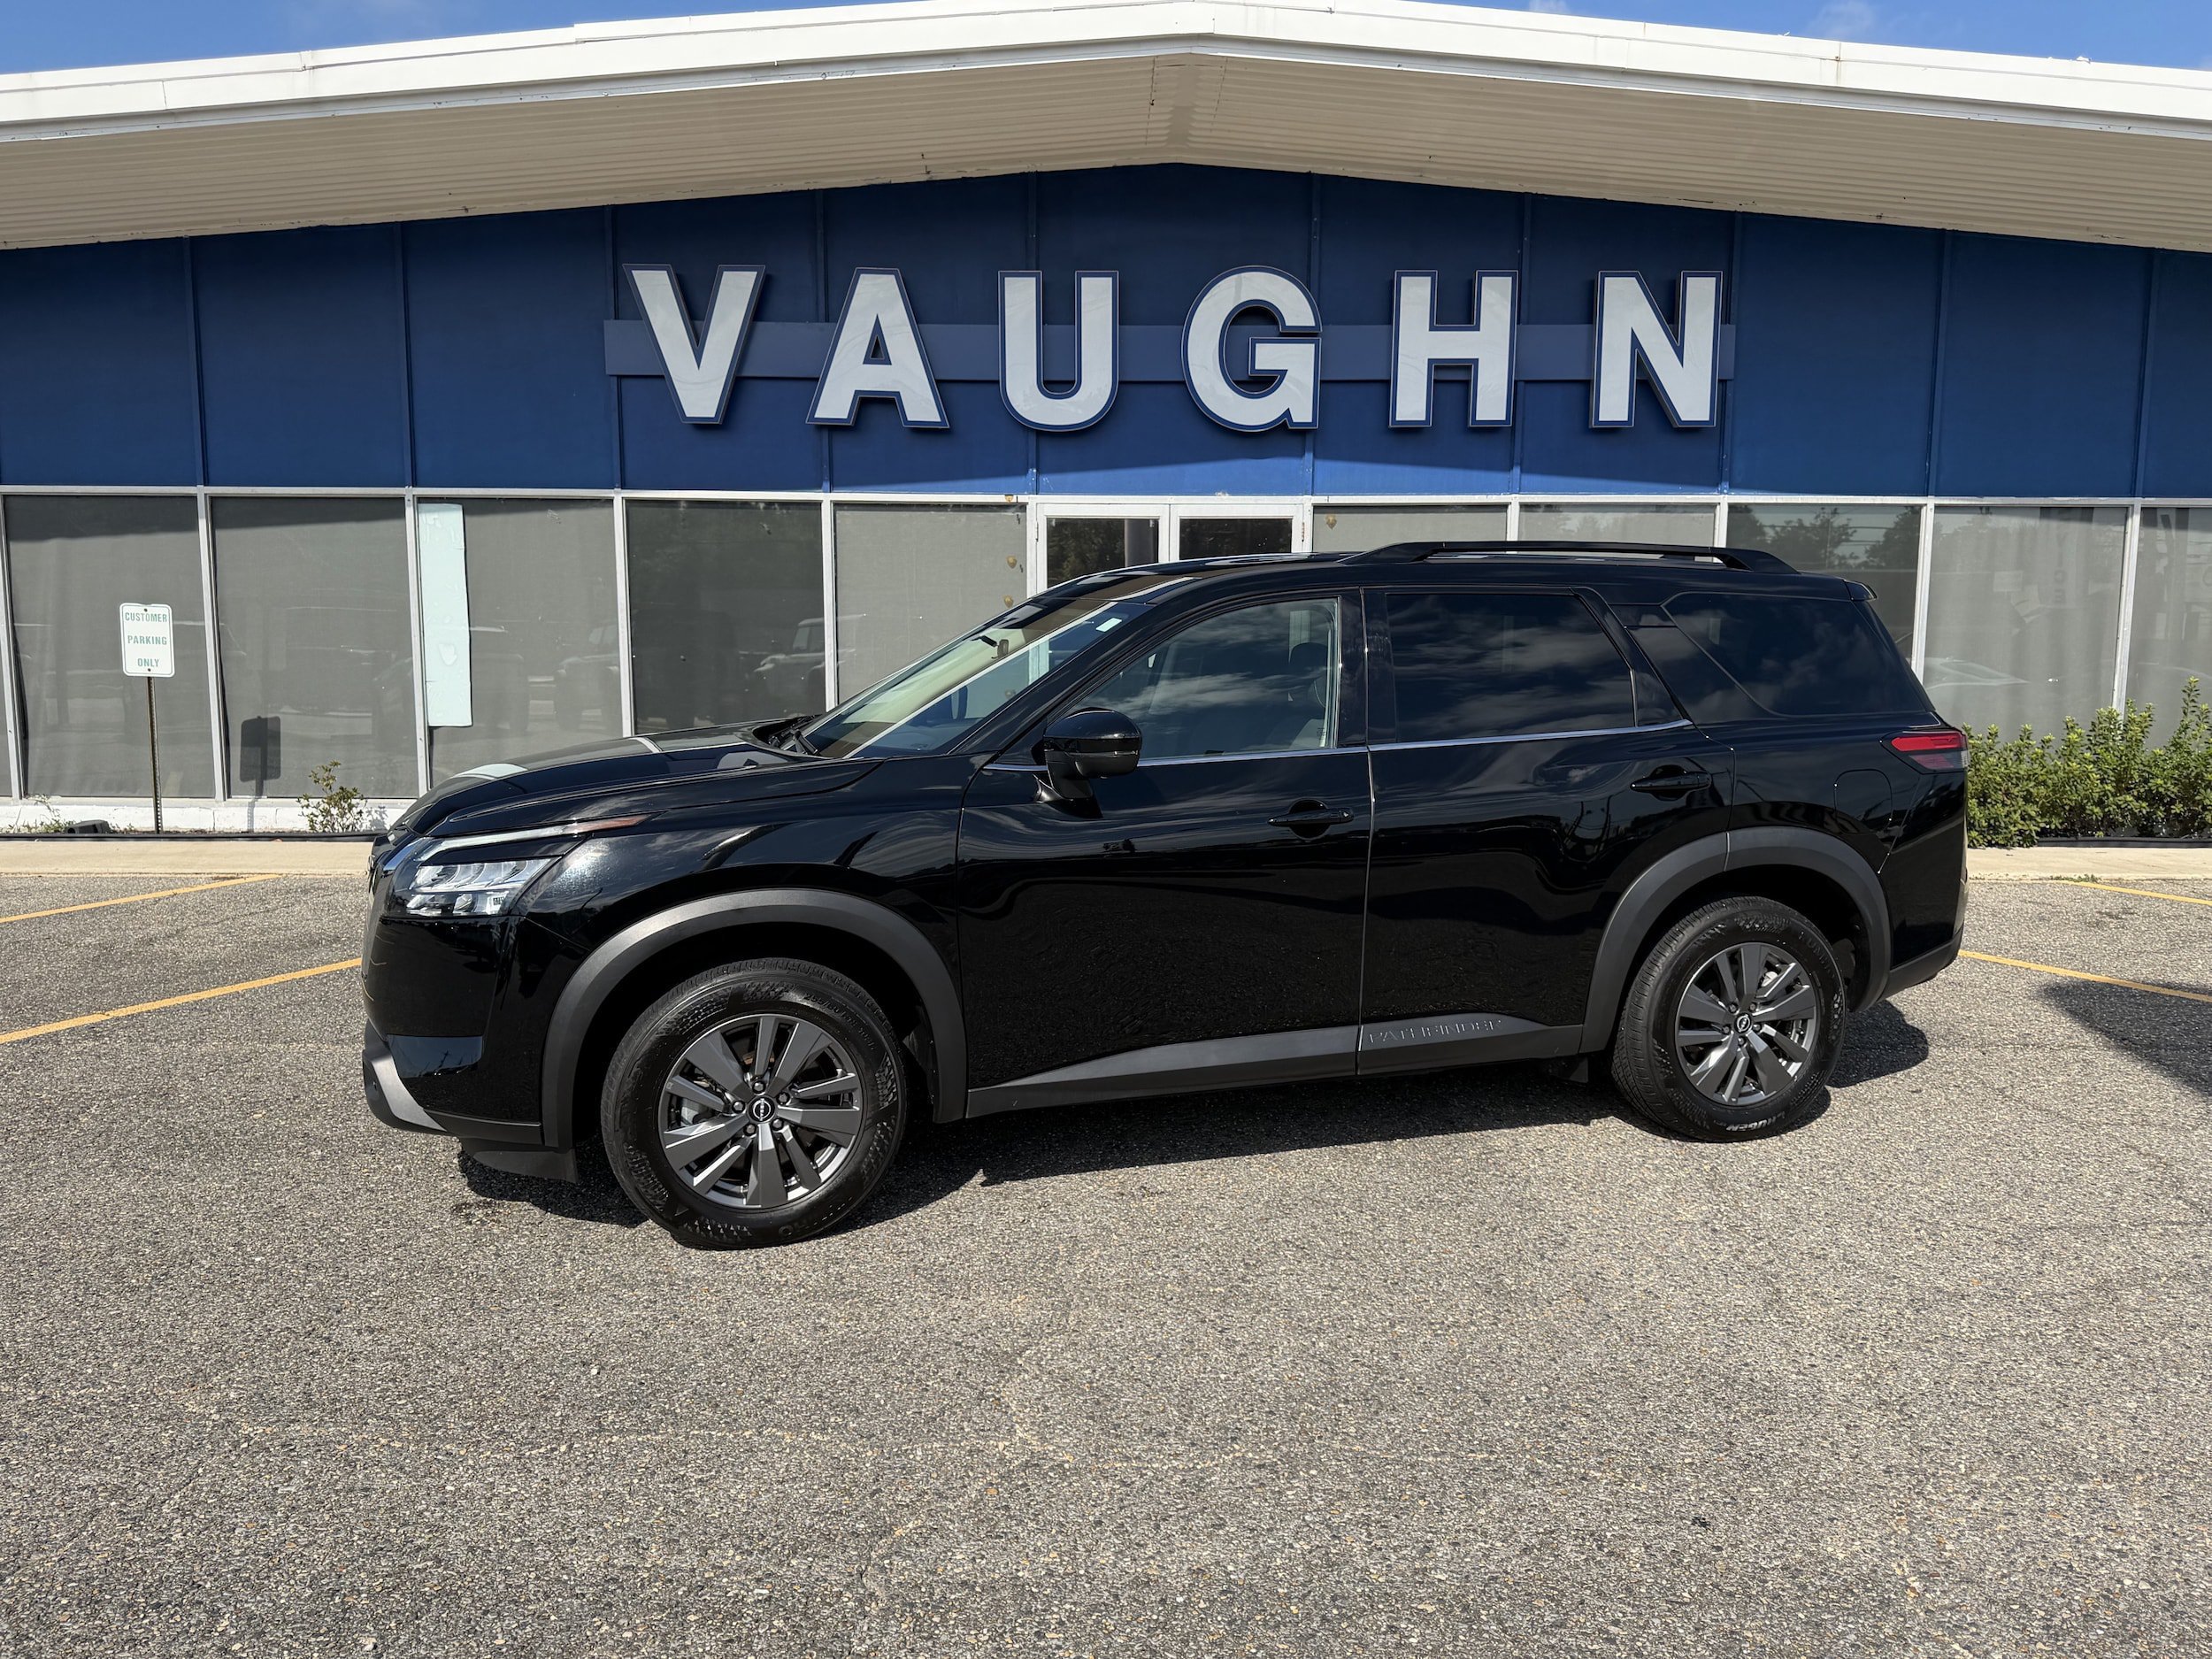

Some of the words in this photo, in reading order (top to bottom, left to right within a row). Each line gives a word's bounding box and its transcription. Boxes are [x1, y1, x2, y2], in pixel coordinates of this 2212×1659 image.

[622, 265, 1724, 433] VAUGHN
[125, 612, 167, 623] CUSTOMER
[127, 635, 167, 645] PARKING
[137, 658, 159, 667] ONLY
[1369, 1019, 1502, 1043] PATHFINDER
